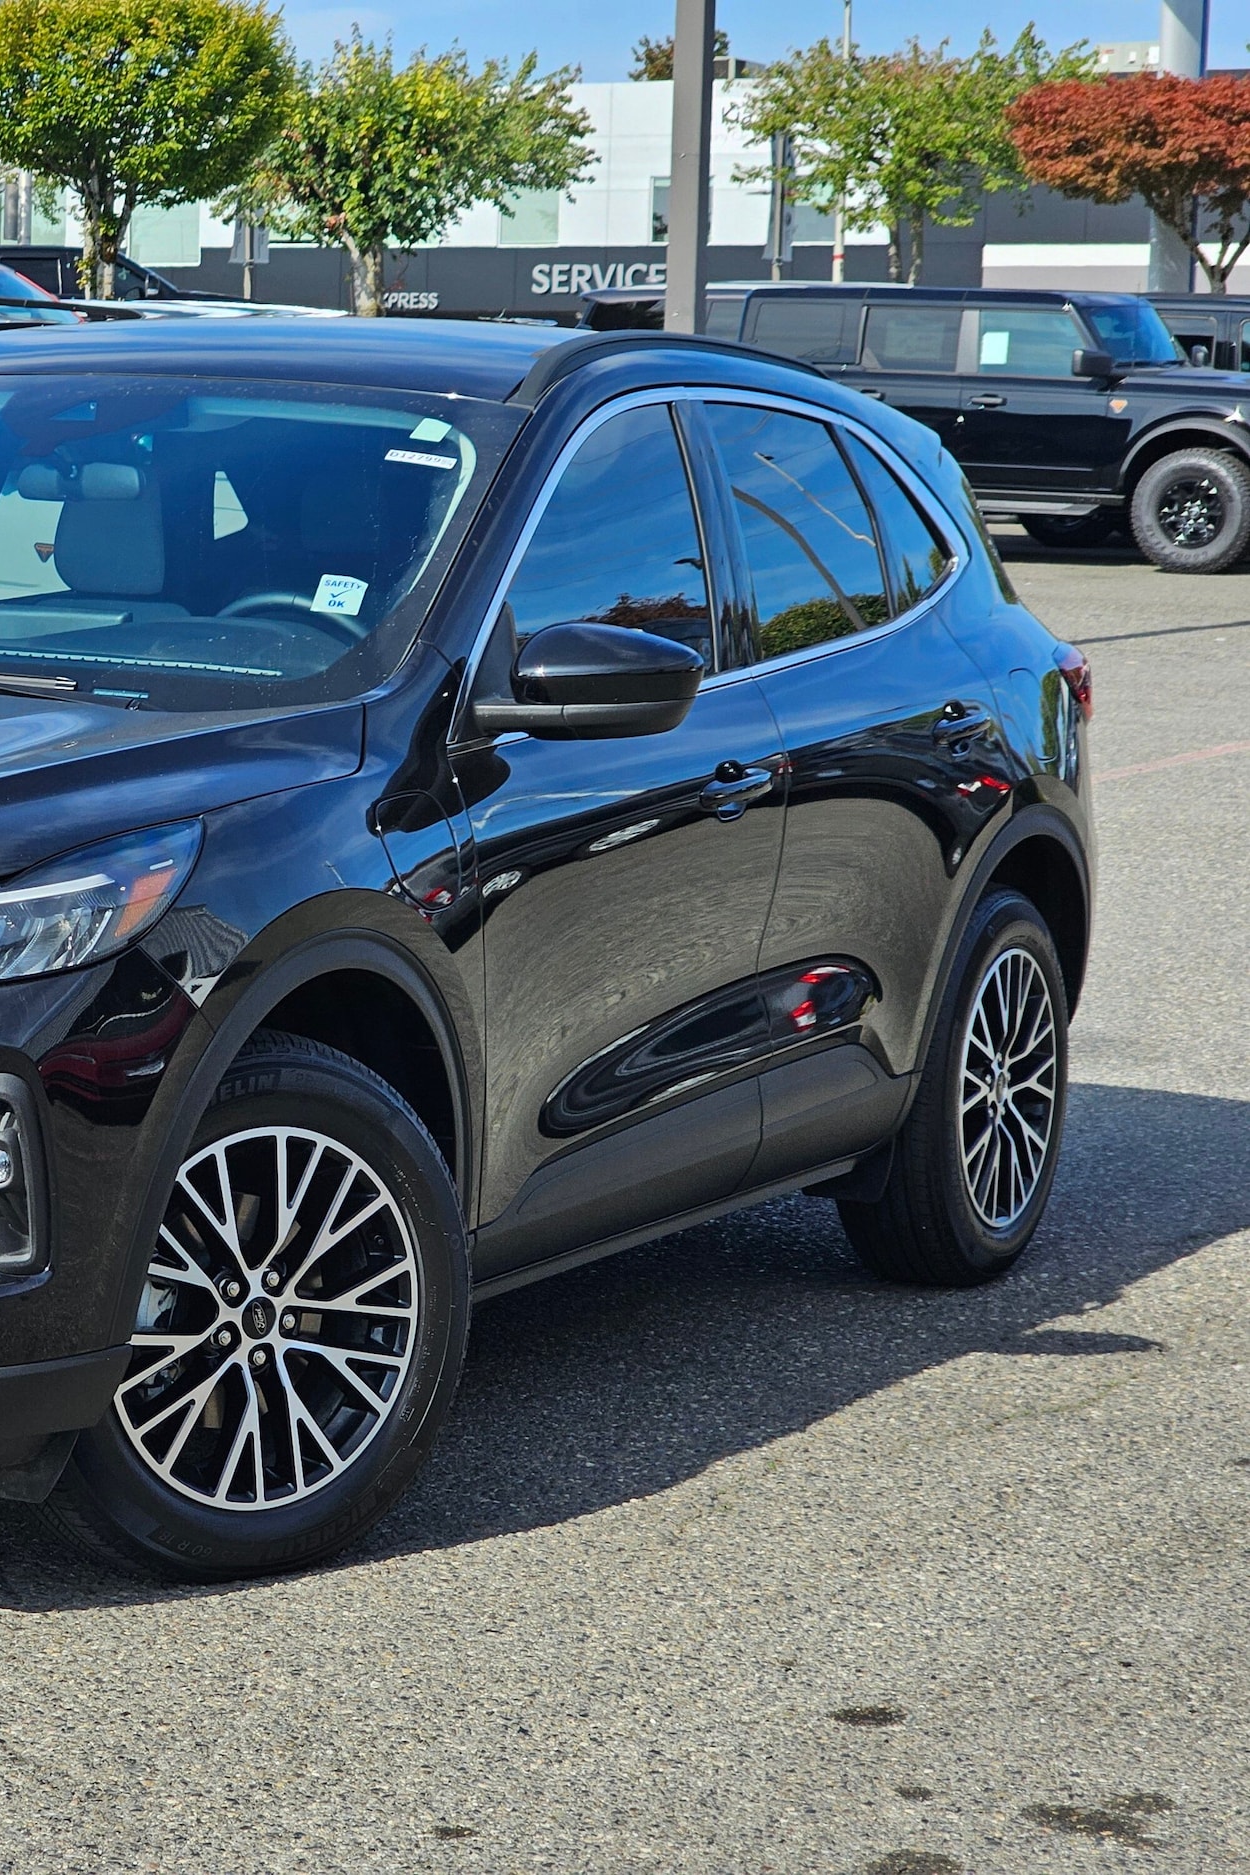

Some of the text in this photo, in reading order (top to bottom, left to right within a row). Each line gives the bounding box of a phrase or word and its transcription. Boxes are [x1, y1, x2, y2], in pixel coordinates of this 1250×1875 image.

[531, 263, 667, 294] SERVICE
[324, 579, 363, 590] SAFETY
[327, 599, 346, 608] OK
